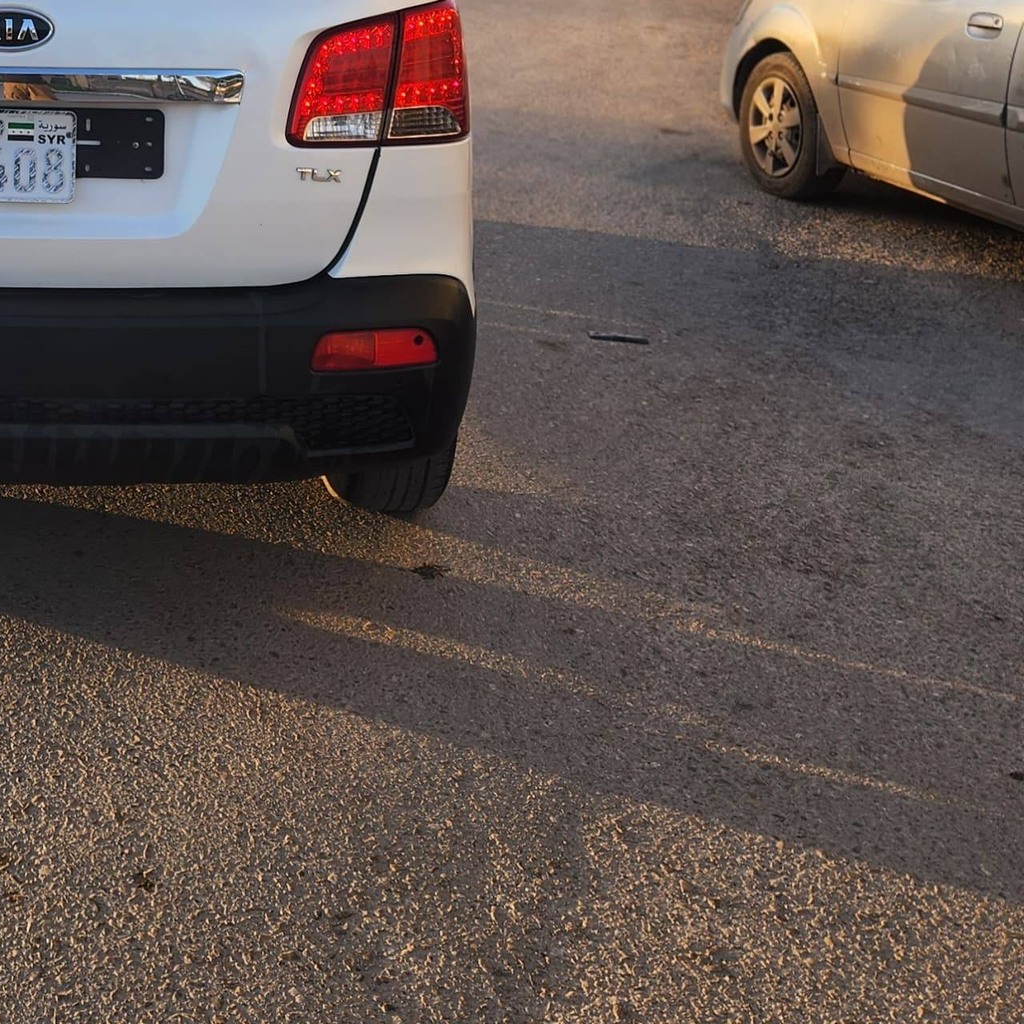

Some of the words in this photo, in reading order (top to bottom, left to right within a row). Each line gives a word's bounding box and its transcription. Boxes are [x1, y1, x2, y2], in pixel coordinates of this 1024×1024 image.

[37, 120, 68, 132] سورية
[37, 134, 67, 145] SYR
[296, 167, 342, 183] TLX
